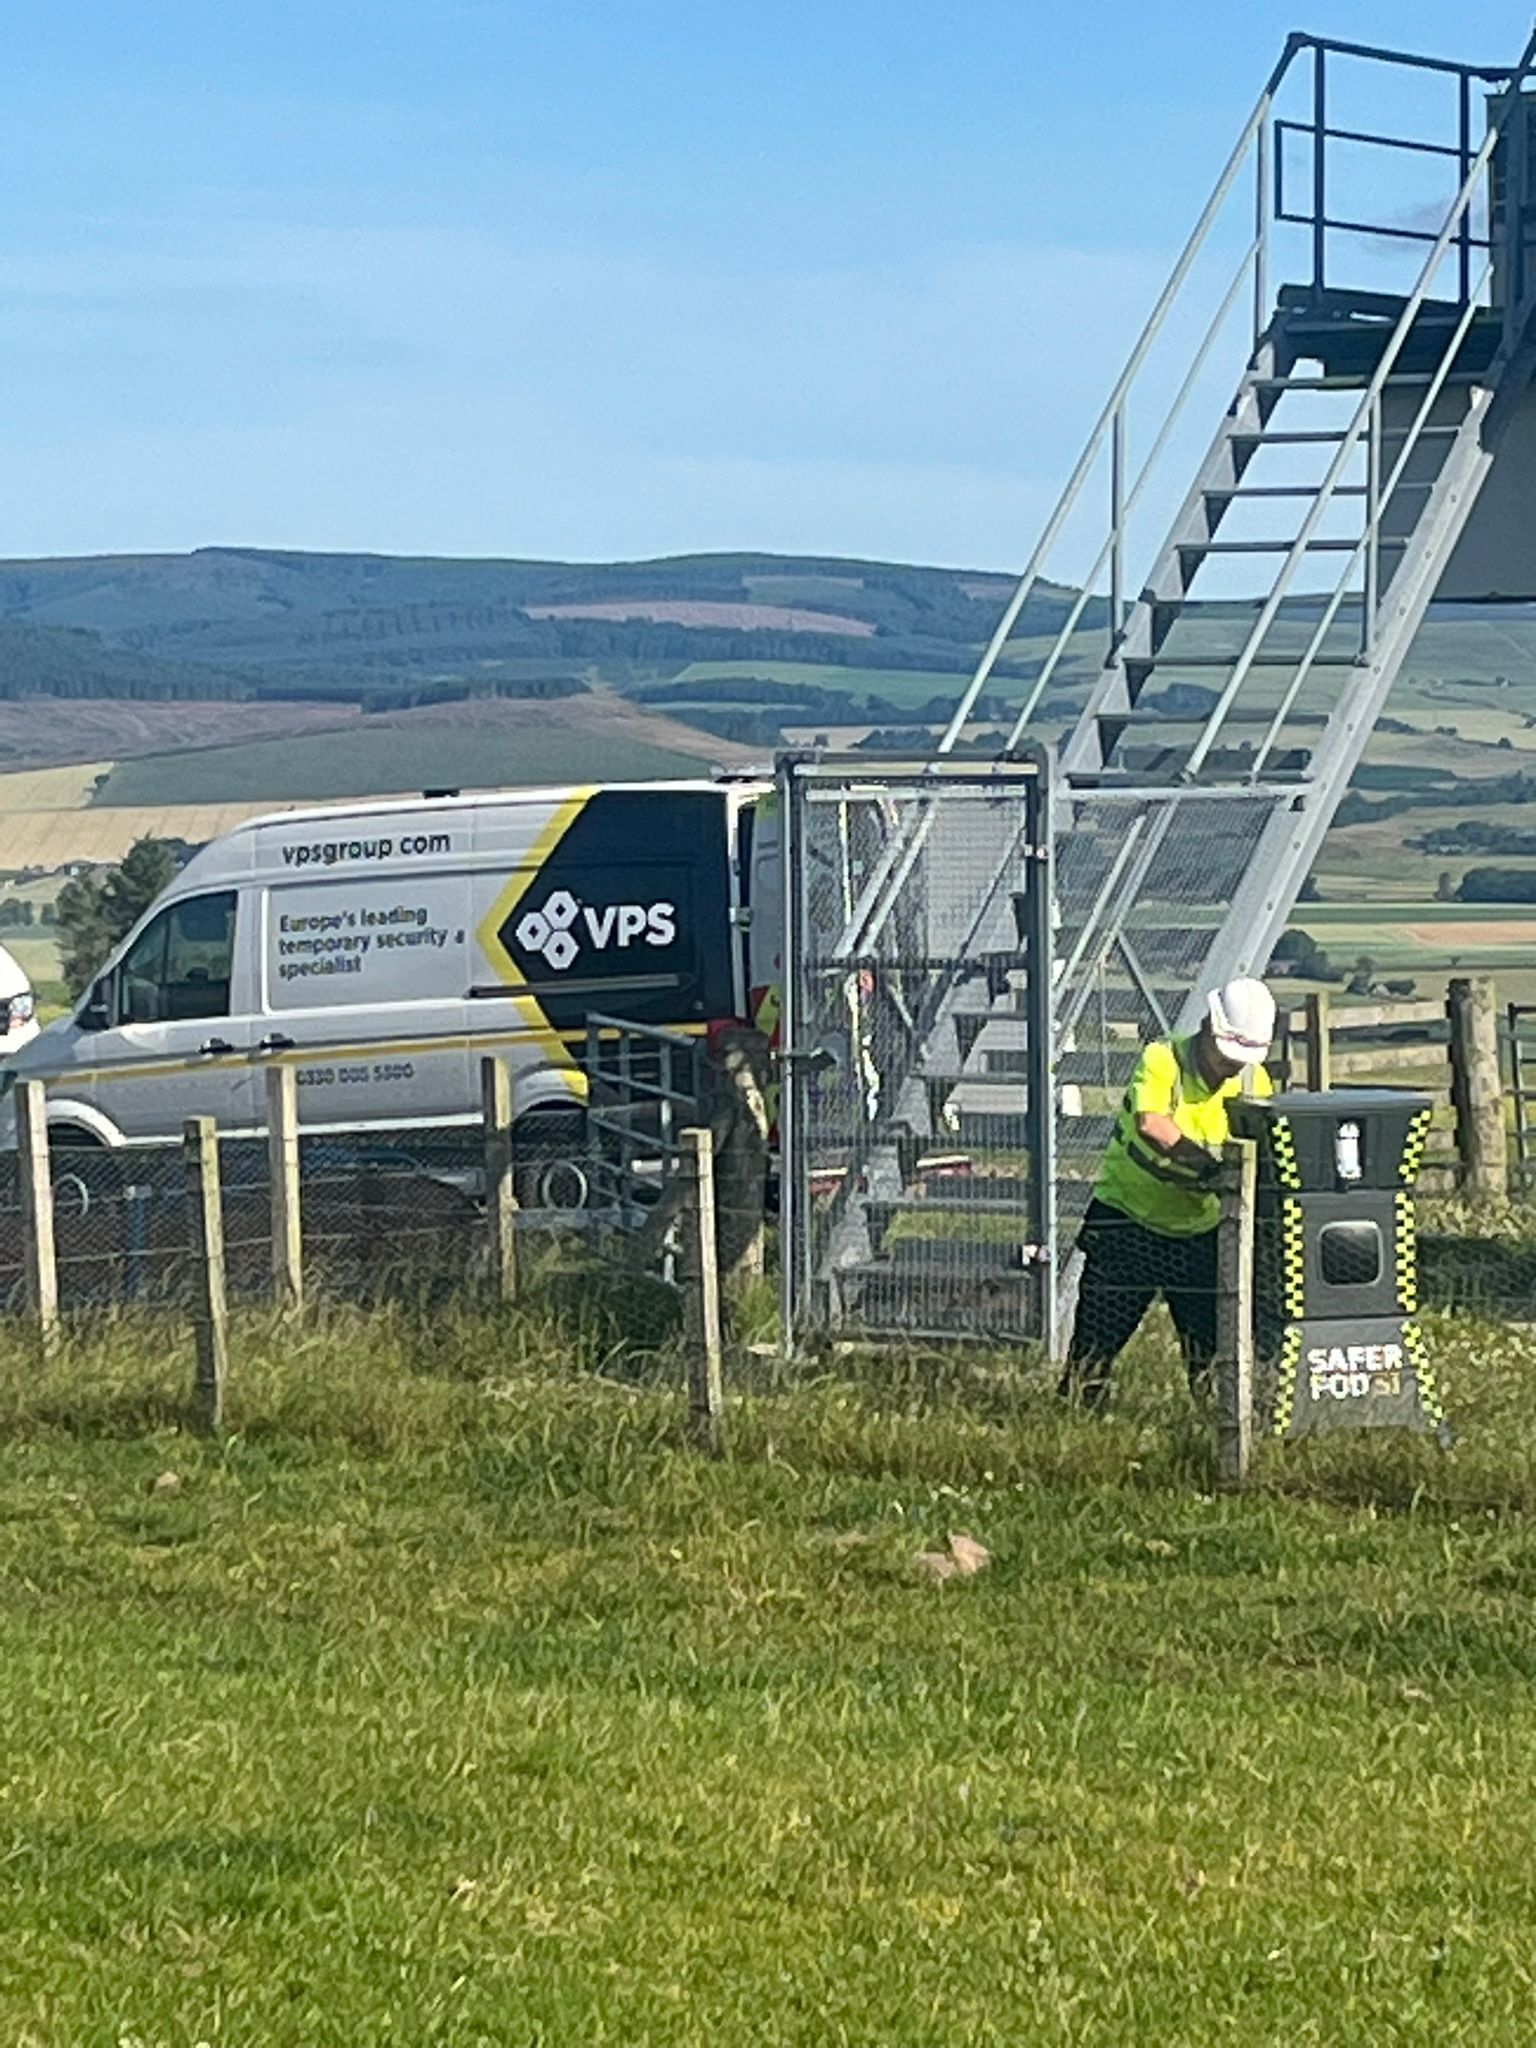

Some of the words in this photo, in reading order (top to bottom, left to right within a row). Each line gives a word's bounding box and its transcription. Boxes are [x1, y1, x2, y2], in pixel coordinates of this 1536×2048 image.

[280, 911, 356, 933] Europe's
[360, 905, 427, 926] leading
[583, 902, 675, 949] VPS
[279, 934, 370, 956] temporary
[376, 927, 448, 949] security
[278, 955, 361, 981] specialist
[1307, 1344, 1402, 1373] SAFER
